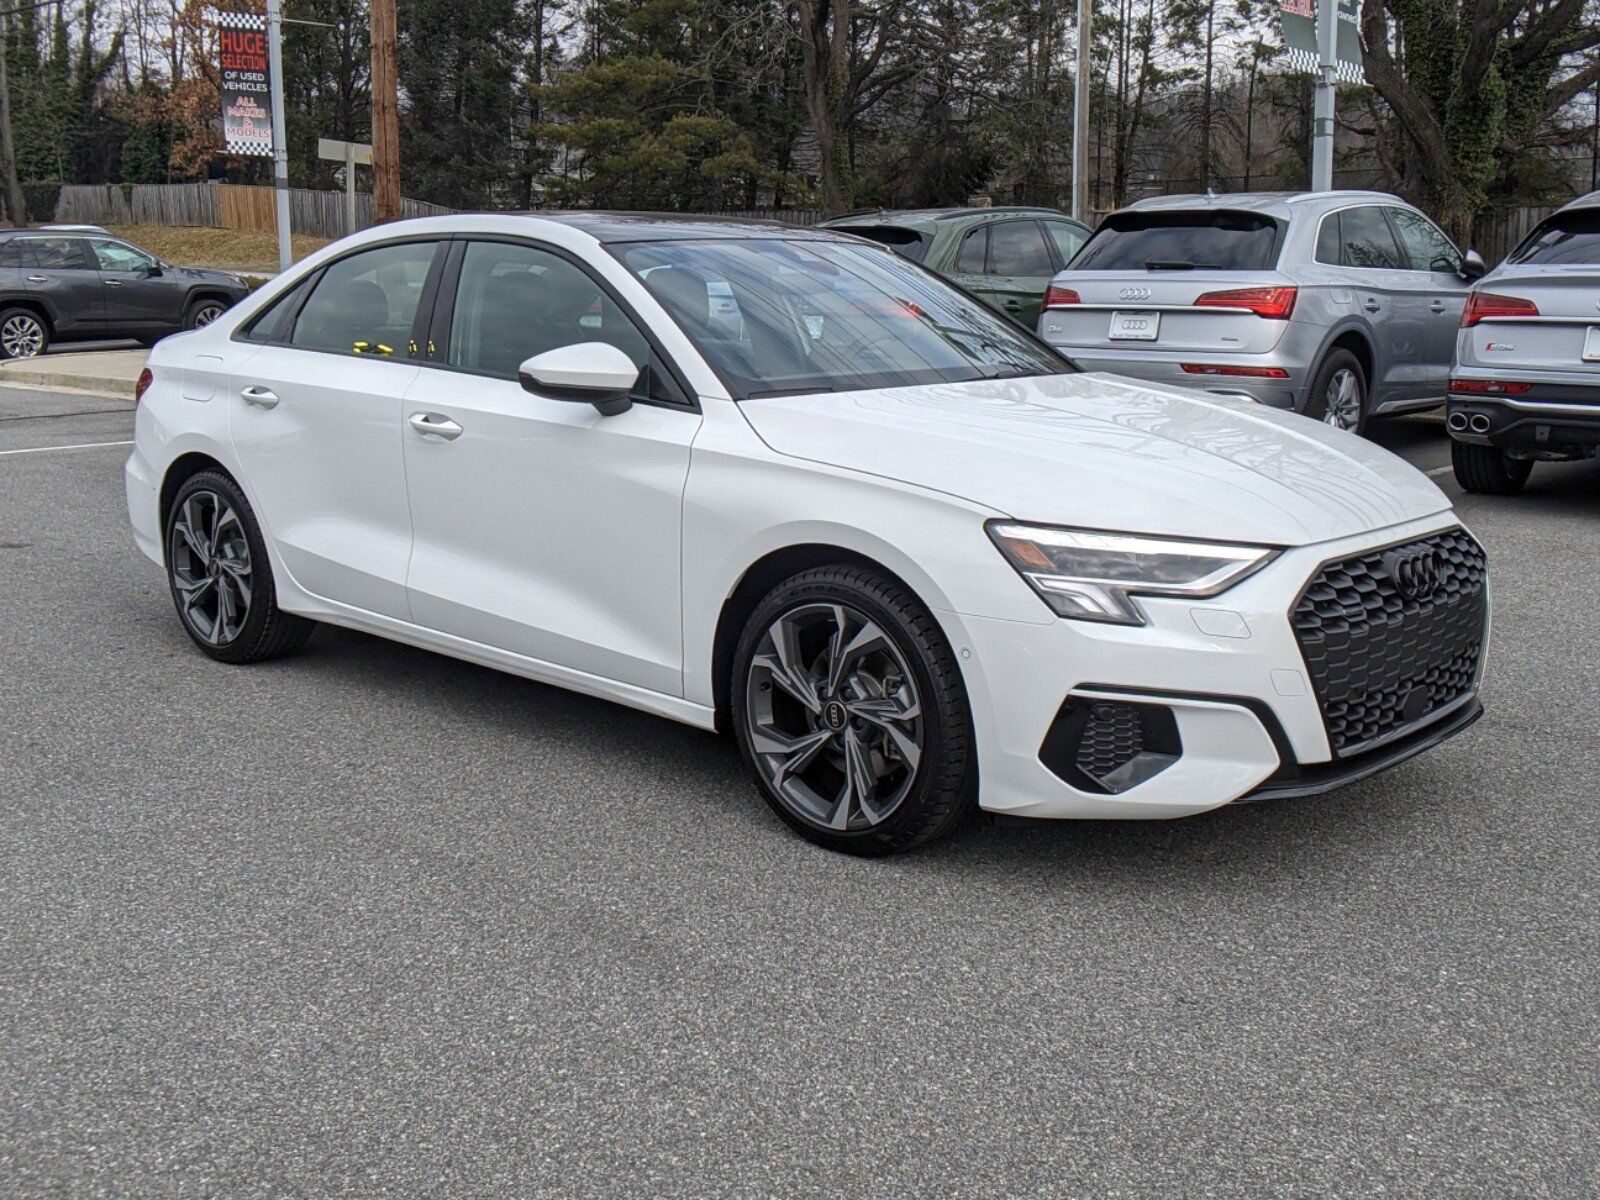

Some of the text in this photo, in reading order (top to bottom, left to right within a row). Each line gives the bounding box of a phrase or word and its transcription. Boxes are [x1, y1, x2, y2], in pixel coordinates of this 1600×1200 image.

[221, 32, 264, 54] HUGE
[221, 54, 266, 70] SELECTION
[224, 71, 265, 81] OF USED
[221, 81, 268, 92] VEHICLES
[235, 96, 257, 106] ALL
[227, 106, 266, 118] MAKES
[226, 128, 270, 138] MODELS
